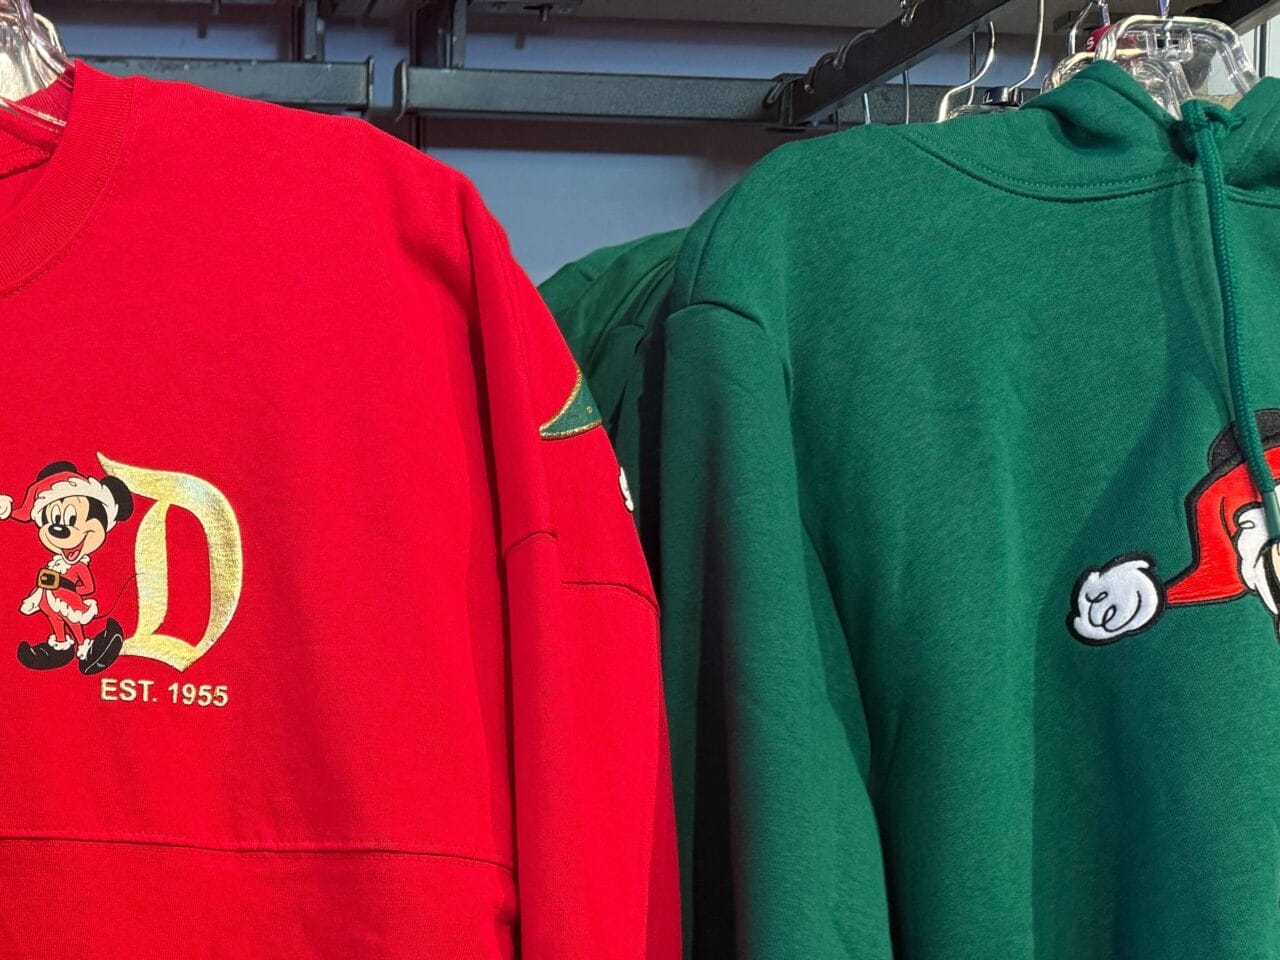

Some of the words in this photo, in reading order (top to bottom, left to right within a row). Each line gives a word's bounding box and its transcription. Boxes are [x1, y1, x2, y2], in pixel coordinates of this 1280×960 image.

[96, 450, 244, 673] D
[100, 678, 158, 703] EST.
[167, 682, 229, 708] 1955
